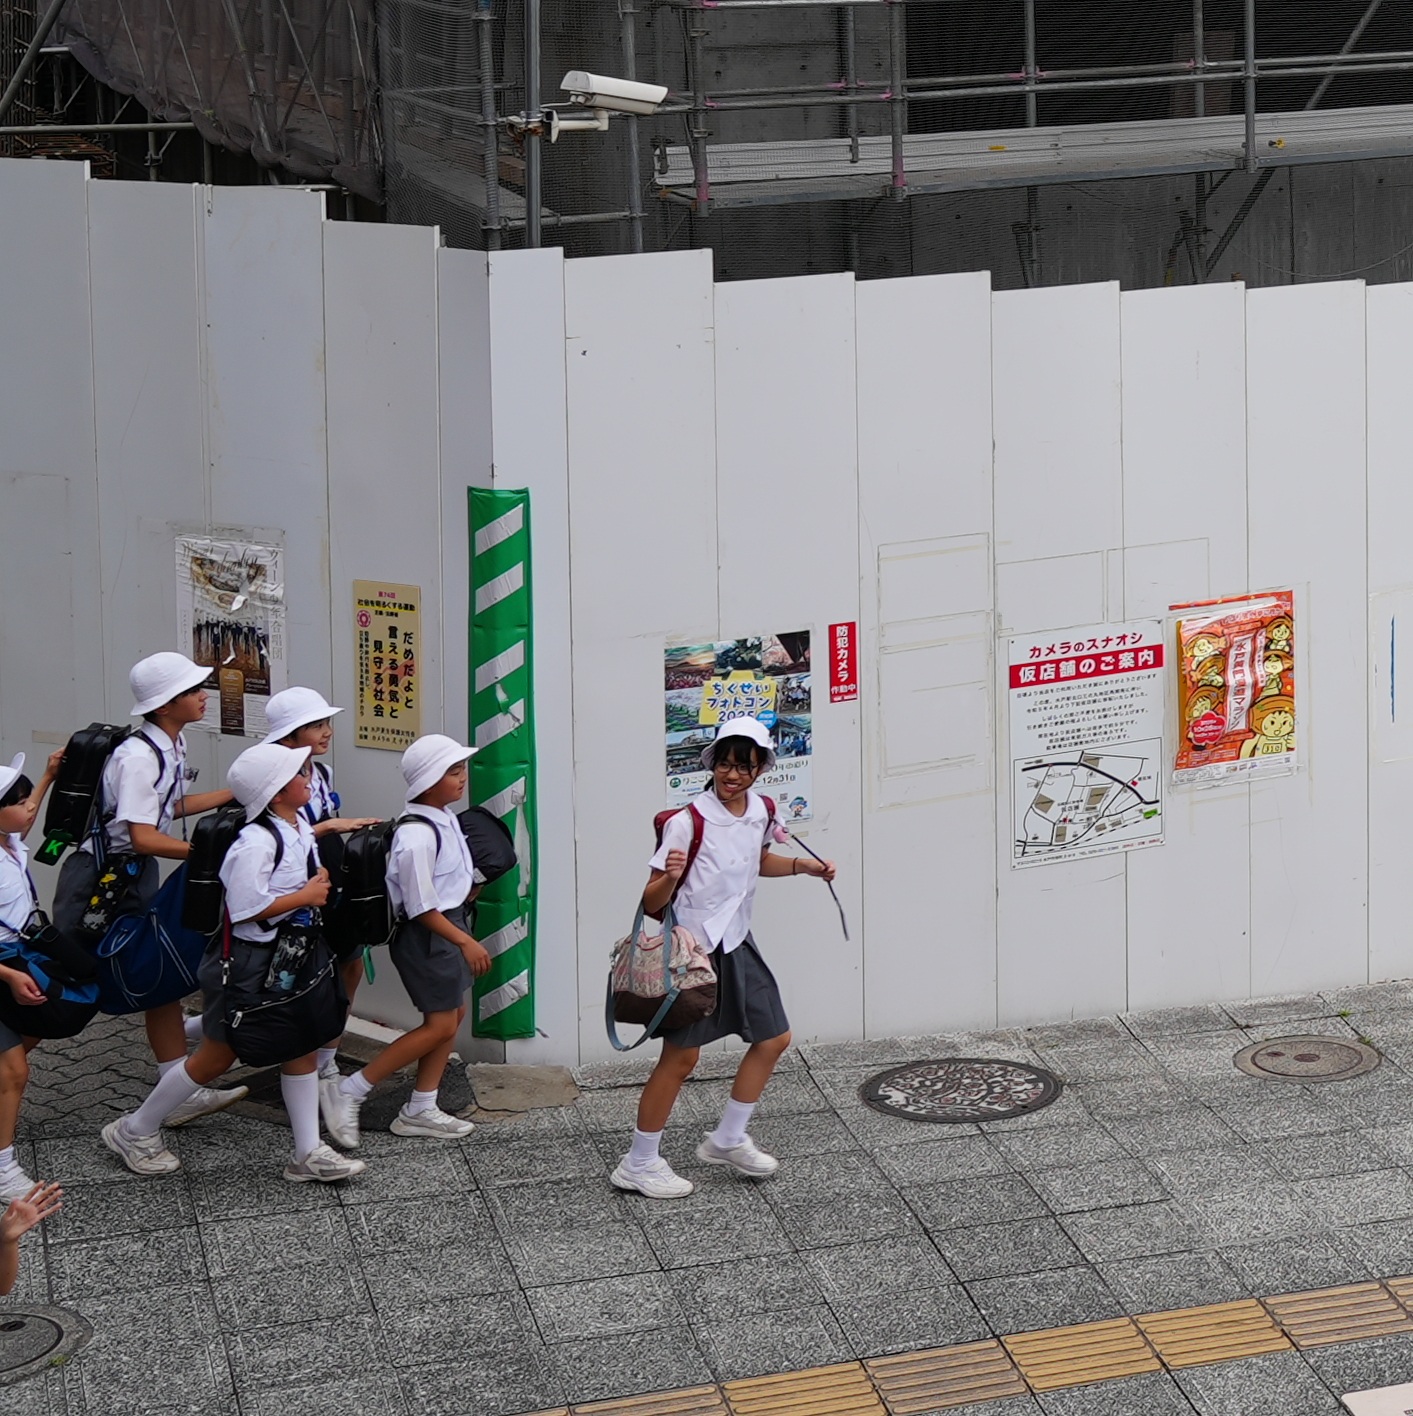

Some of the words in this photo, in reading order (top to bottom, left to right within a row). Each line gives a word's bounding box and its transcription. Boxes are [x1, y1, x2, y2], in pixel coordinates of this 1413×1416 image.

[357, 598, 416, 611] 社会を明るくする運動
[836, 625, 850, 683] 防犯カメラ
[1029, 632, 1143, 659] カメラのスナオシ
[373, 639, 385, 718] 見守る社会
[388, 625, 400, 719] 言える勇気と
[403, 631, 414, 710] だめだよと
[1019, 649, 1155, 684] 仮店舗のご案内
[712, 682, 770, 695] ちくせい
[830, 683, 857, 695] 作動中
[706, 696, 772, 709] フォトコン
[45, 840, 64, 856] K
